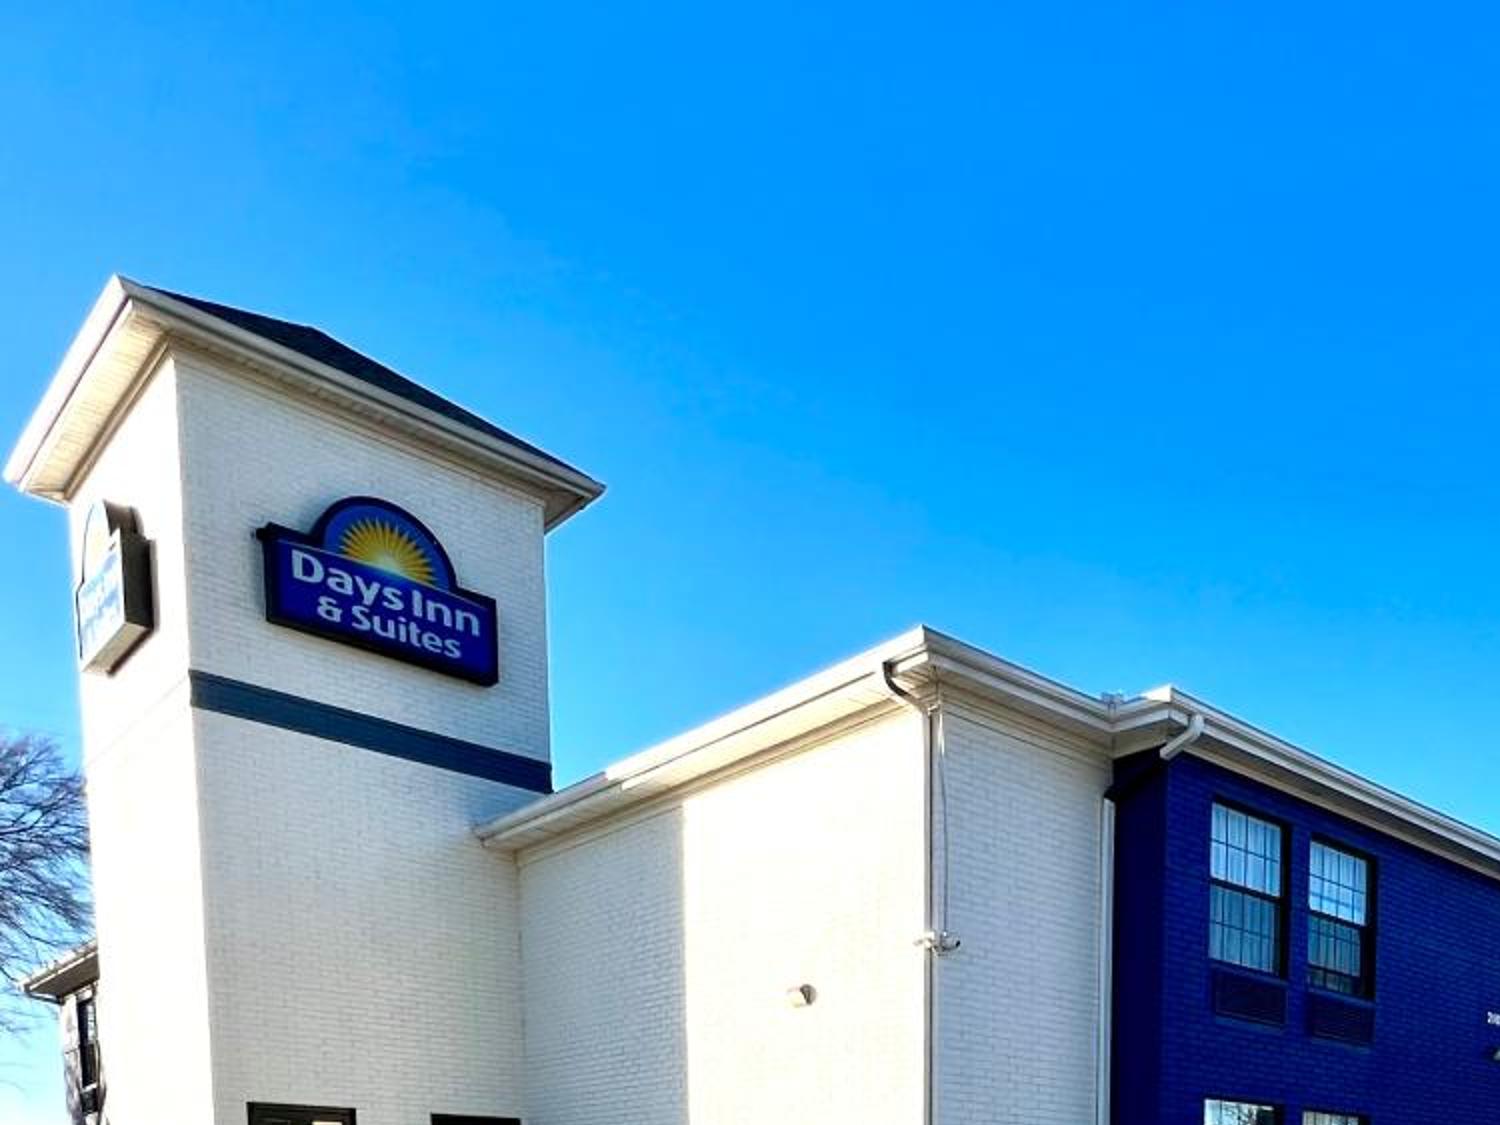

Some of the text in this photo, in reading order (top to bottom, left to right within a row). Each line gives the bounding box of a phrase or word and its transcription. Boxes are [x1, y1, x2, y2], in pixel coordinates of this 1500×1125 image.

[291, 549, 480, 637] Days Inn
[317, 596, 462, 659] & Suites
